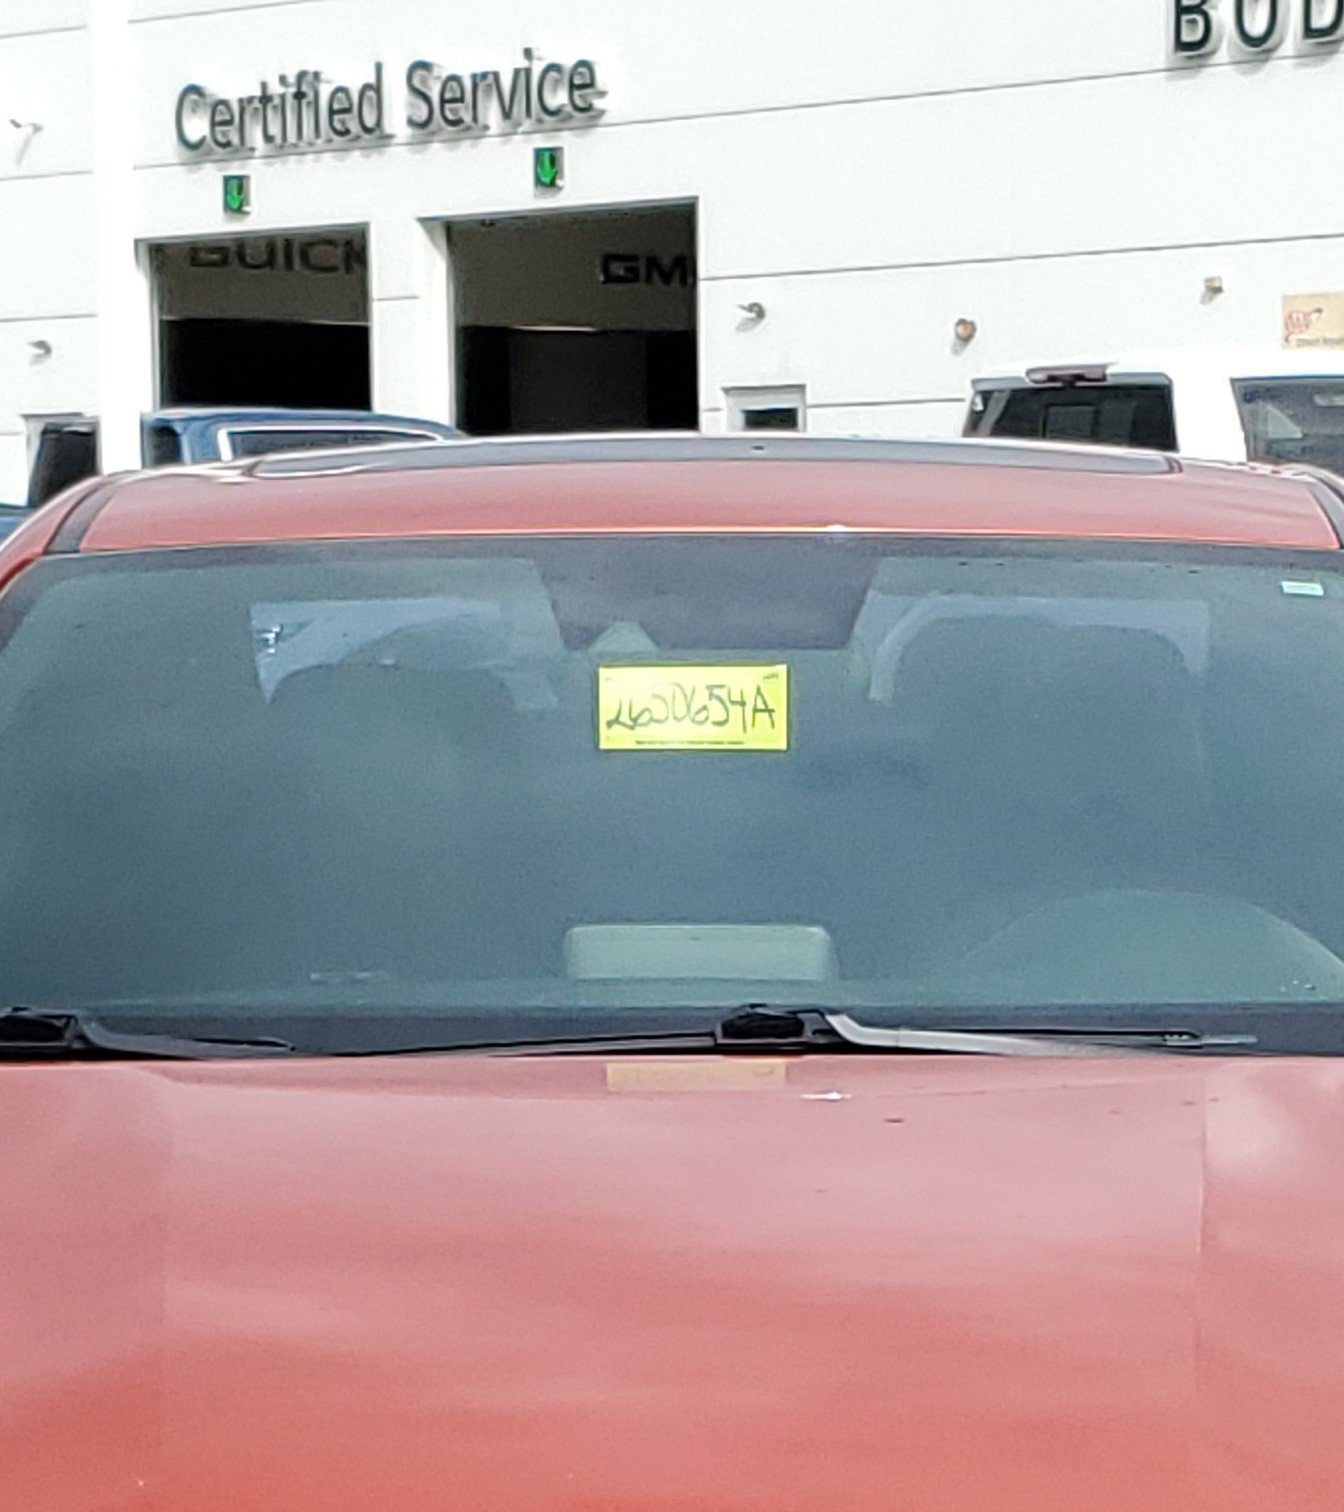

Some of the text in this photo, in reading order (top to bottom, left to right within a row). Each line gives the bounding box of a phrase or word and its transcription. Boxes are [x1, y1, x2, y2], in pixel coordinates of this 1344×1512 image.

[174, 46, 598, 152] Certified Service
[602, 253, 696, 288] GM
